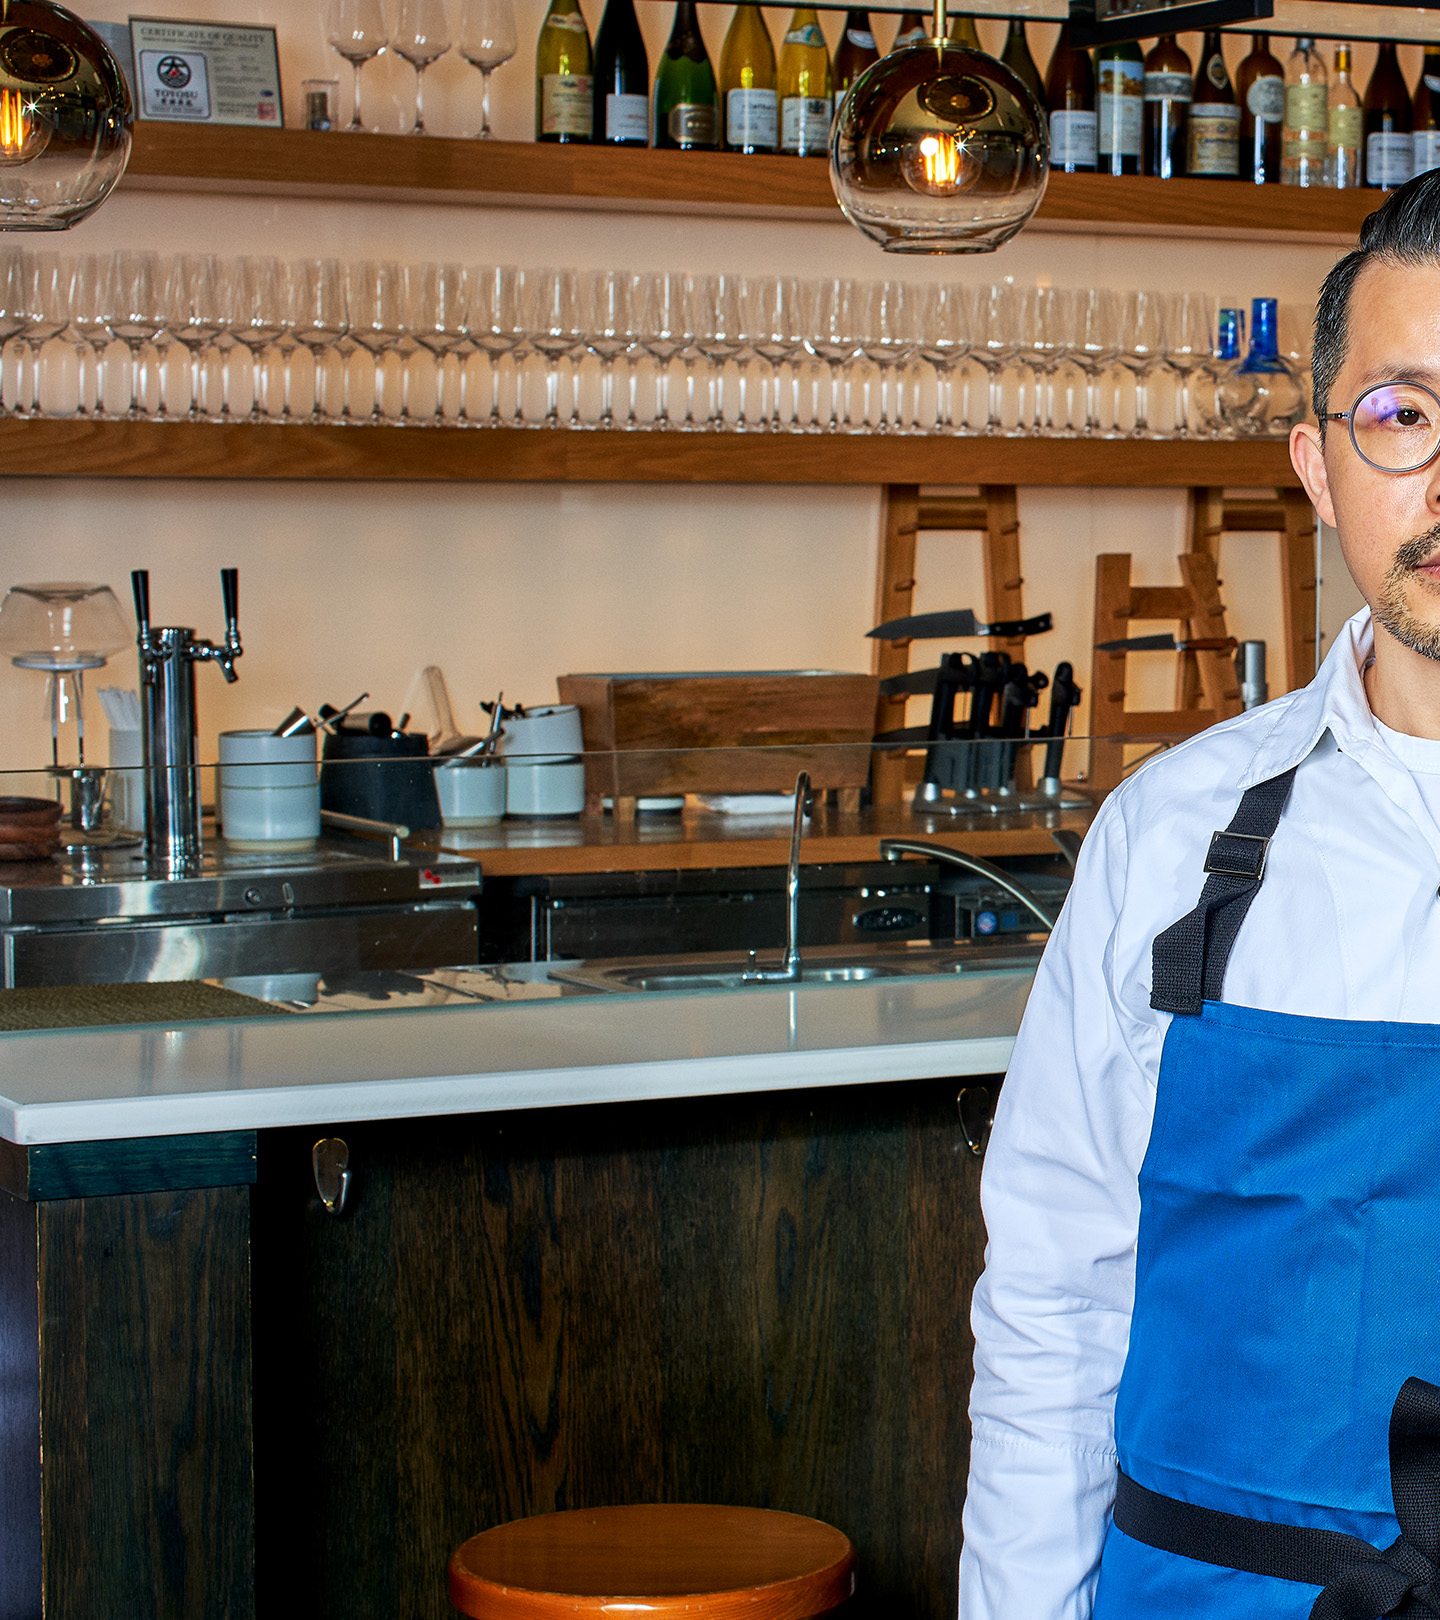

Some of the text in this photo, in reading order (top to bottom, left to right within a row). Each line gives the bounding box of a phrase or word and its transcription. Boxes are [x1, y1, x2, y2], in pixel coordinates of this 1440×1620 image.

[141, 27, 205, 39] CERTIFICATE
[208, 32, 220, 40] OF
[222, 33, 265, 43] QUALITY
